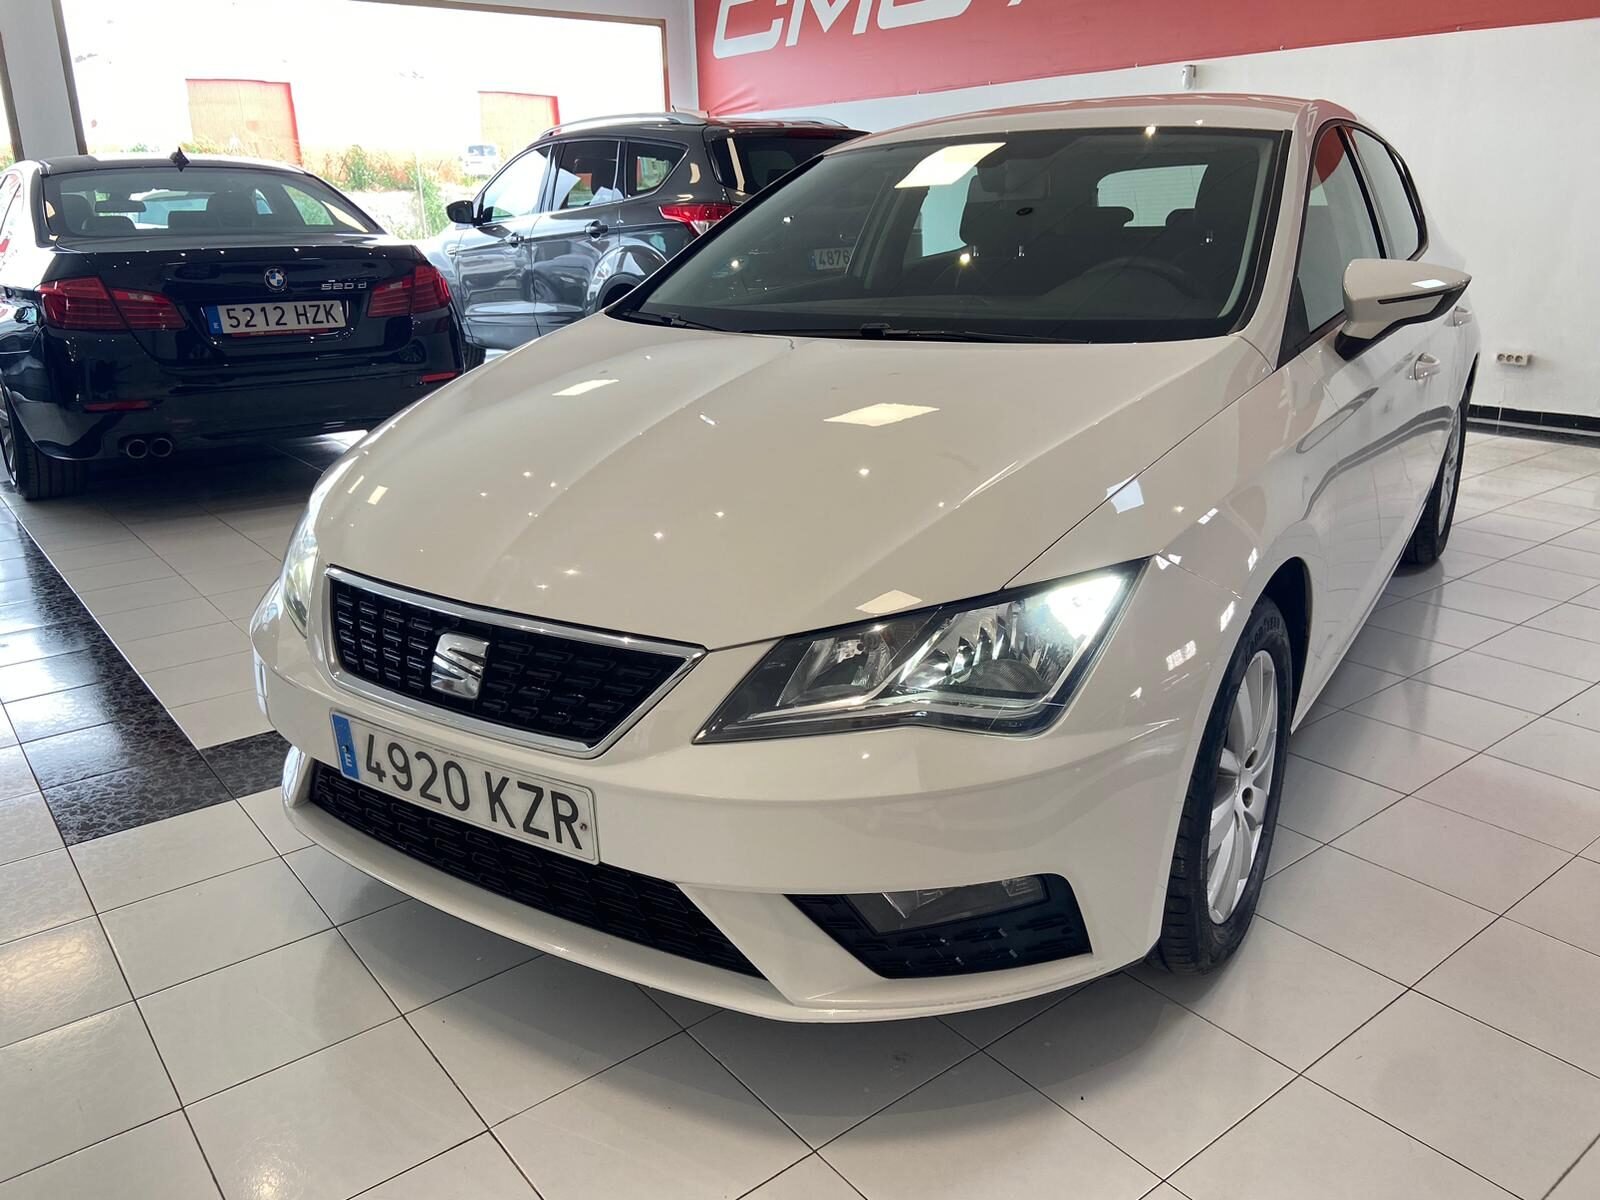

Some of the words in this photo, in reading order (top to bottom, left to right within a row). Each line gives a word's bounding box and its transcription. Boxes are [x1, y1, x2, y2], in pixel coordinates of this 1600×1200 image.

[819, 249, 850, 265] 4876
[226, 306, 287, 328] 5212
[294, 303, 338, 325] HZK
[365, 734, 470, 811] 4920
[484, 771, 582, 850] KZR
